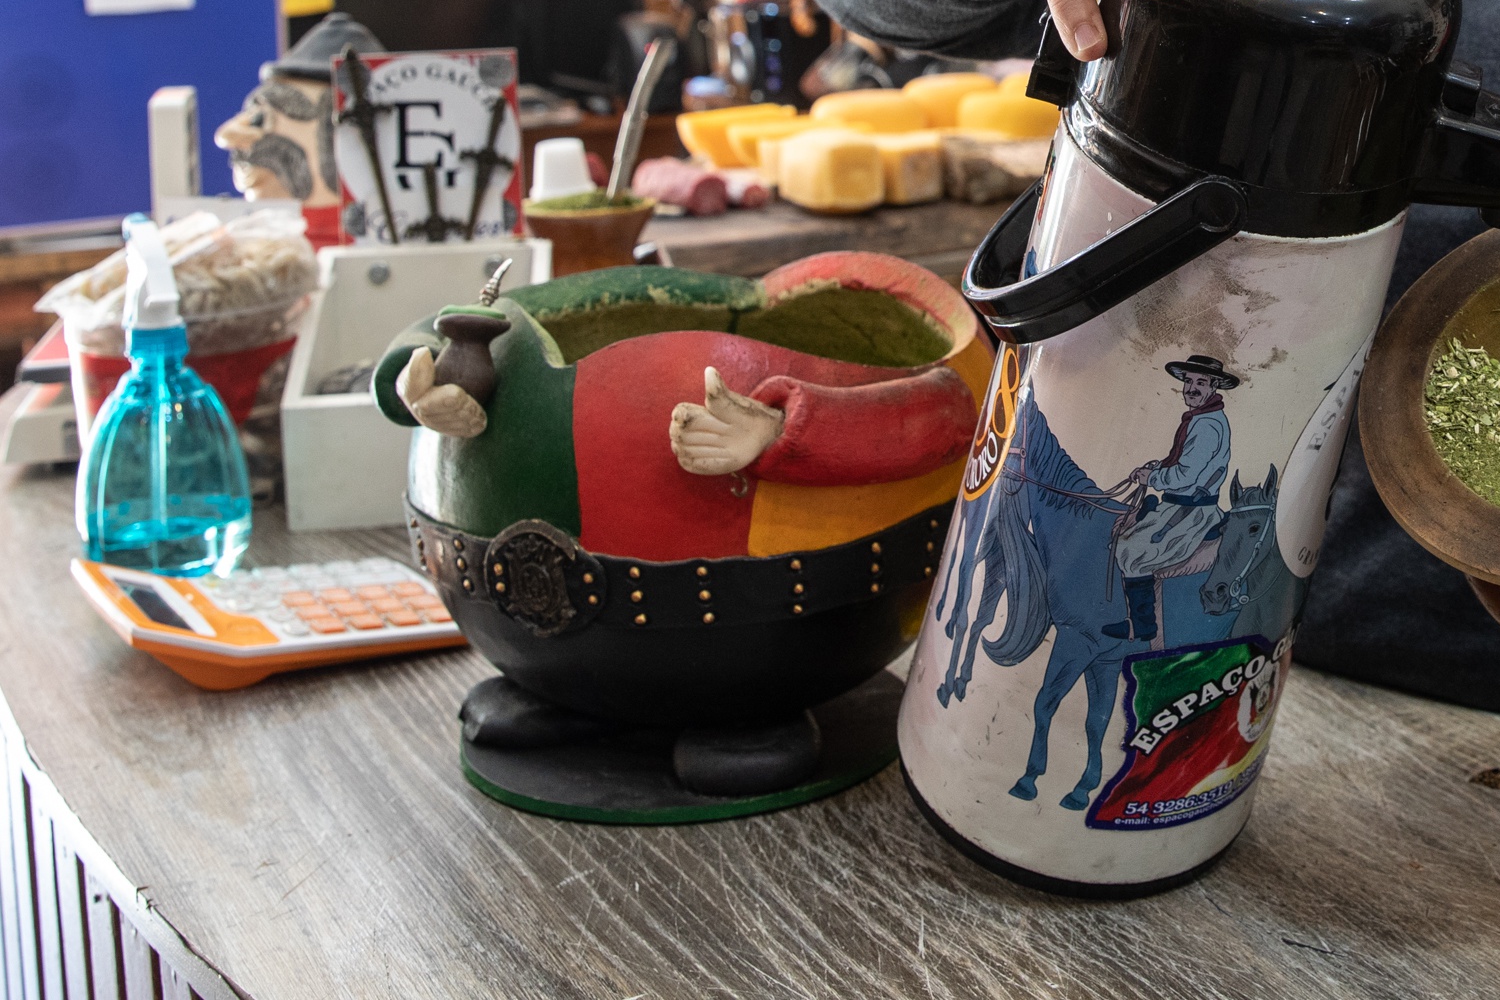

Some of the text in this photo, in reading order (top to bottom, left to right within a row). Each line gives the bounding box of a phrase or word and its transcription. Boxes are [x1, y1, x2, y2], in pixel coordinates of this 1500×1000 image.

[1130, 654, 1266, 755] ESPAÇO
[1125, 780, 1234, 815] 54 3286.3519
[1114, 816, 1151, 825] e-mail:
